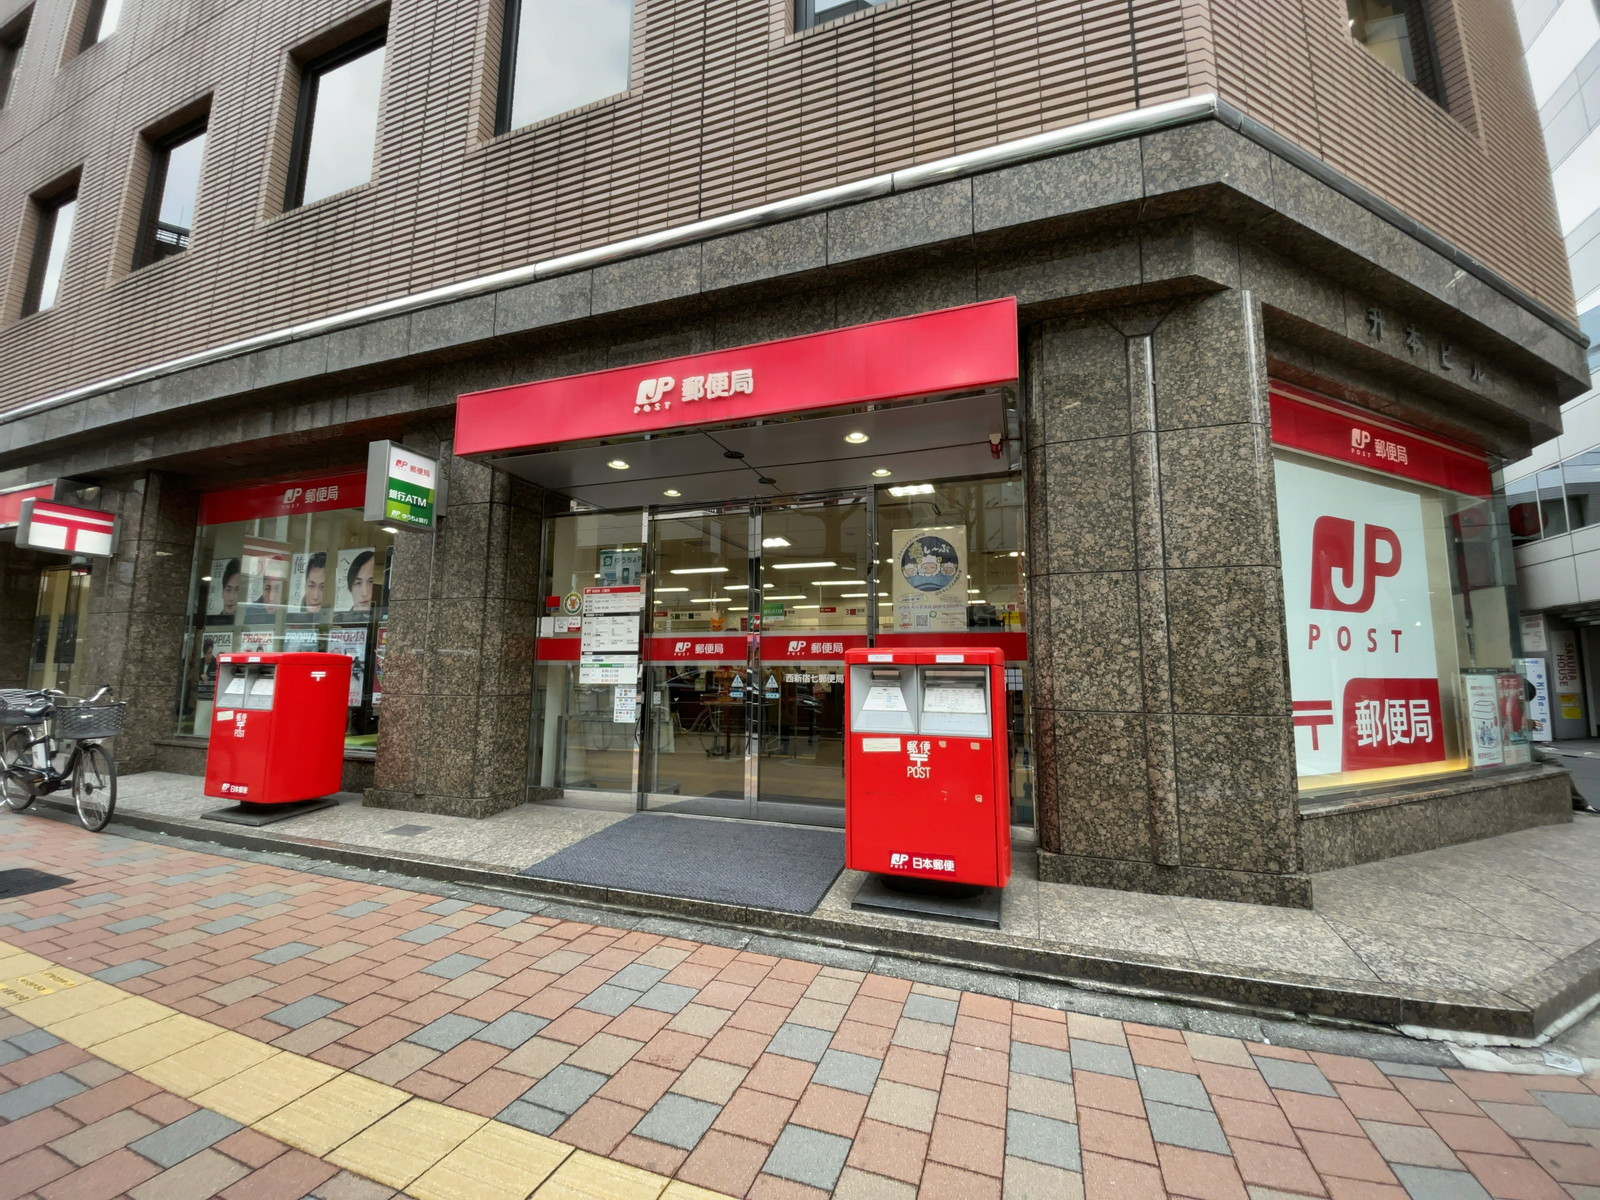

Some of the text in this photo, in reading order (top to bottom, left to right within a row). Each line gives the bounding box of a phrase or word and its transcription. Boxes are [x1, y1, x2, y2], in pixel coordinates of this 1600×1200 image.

[636, 368, 753, 405] JP 郵便局
[633, 401, 671, 414] POST
[1351, 428, 1408, 465] JP 郵便局
[1351, 448, 1372, 458] POST
[409, 464, 431, 478] 郵便局
[283, 485, 338, 504] JP 郵便局
[388, 488, 427, 507] 銀行ATM
[1310, 515, 1402, 613] JP
[845, 608, 850, 616] 3
[330, 630, 366, 643] PROPIA
[1308, 623, 1402, 654] POST
[674, 642, 724, 655] JP 郵便局
[788, 640, 844, 655] JP 郵便局
[1555, 654, 1569, 687] HOUSE
[1563, 643, 1578, 682] SAKURA
[785, 673, 845, 684] 西新宿七郵便局
[1355, 698, 1433, 748] 郵便局
[906, 740, 931, 755] 郵便
[906, 766, 932, 779] POST
[891, 853, 956, 872] JP 日本郵便
